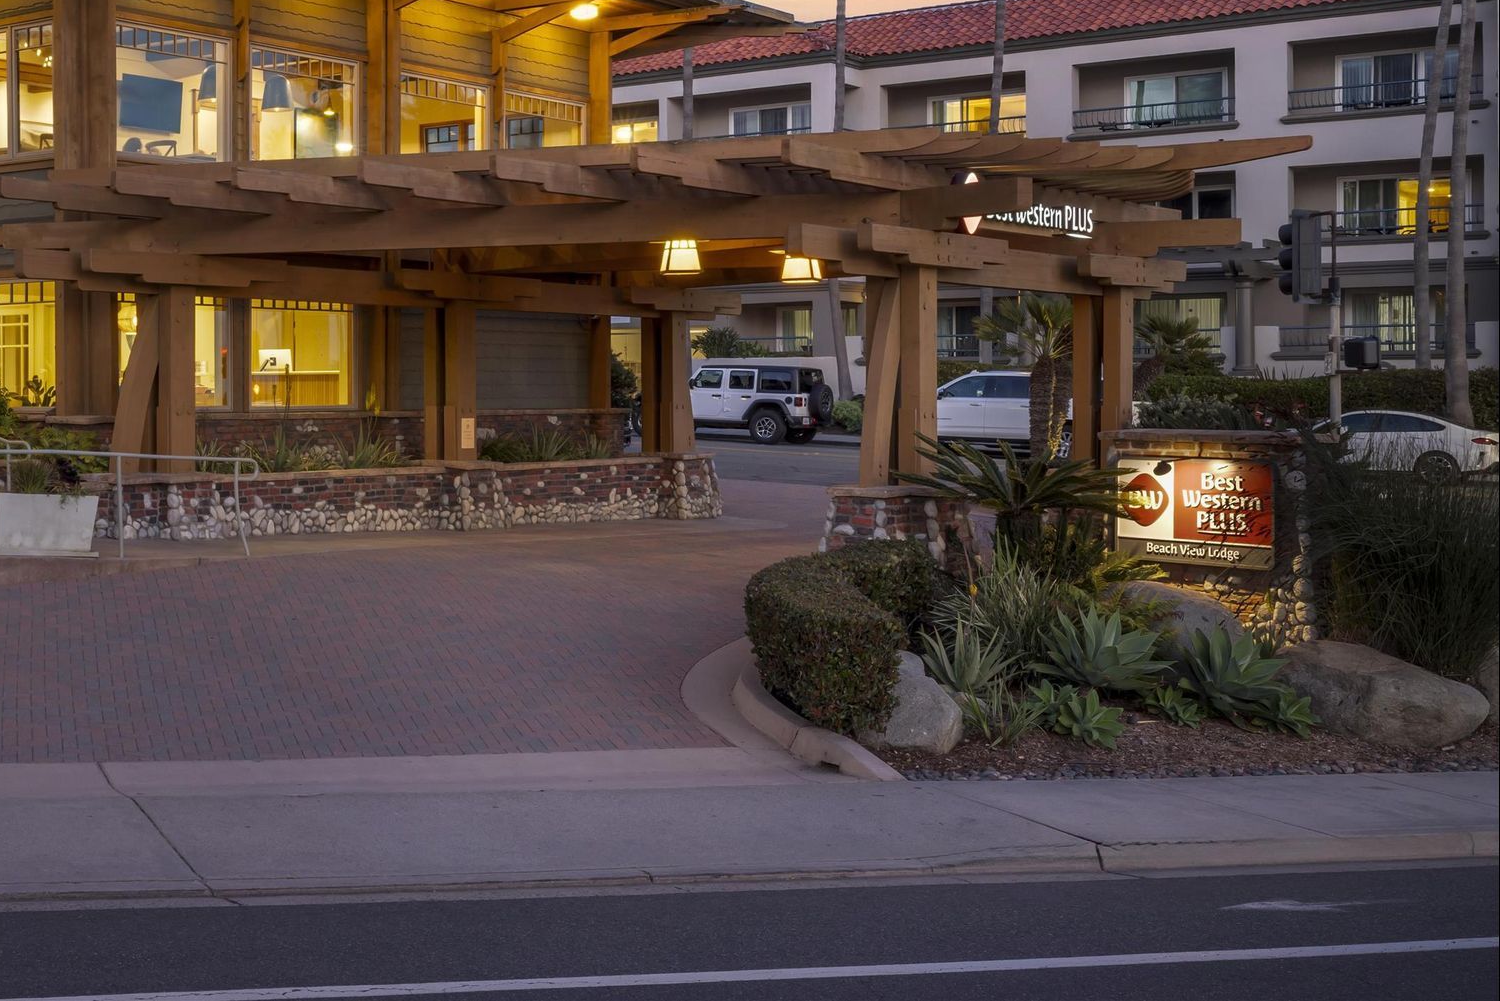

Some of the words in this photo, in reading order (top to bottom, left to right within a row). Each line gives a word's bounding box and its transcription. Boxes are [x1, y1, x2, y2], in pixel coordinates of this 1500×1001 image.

[1065, 205, 1093, 233] PLUS
[1201, 472, 1243, 491] Best
[1182, 489, 1261, 511] Western
[1146, 542, 1177, 556] Beach
[1180, 544, 1205, 557] View
[1208, 549, 1240, 561] Lodge
